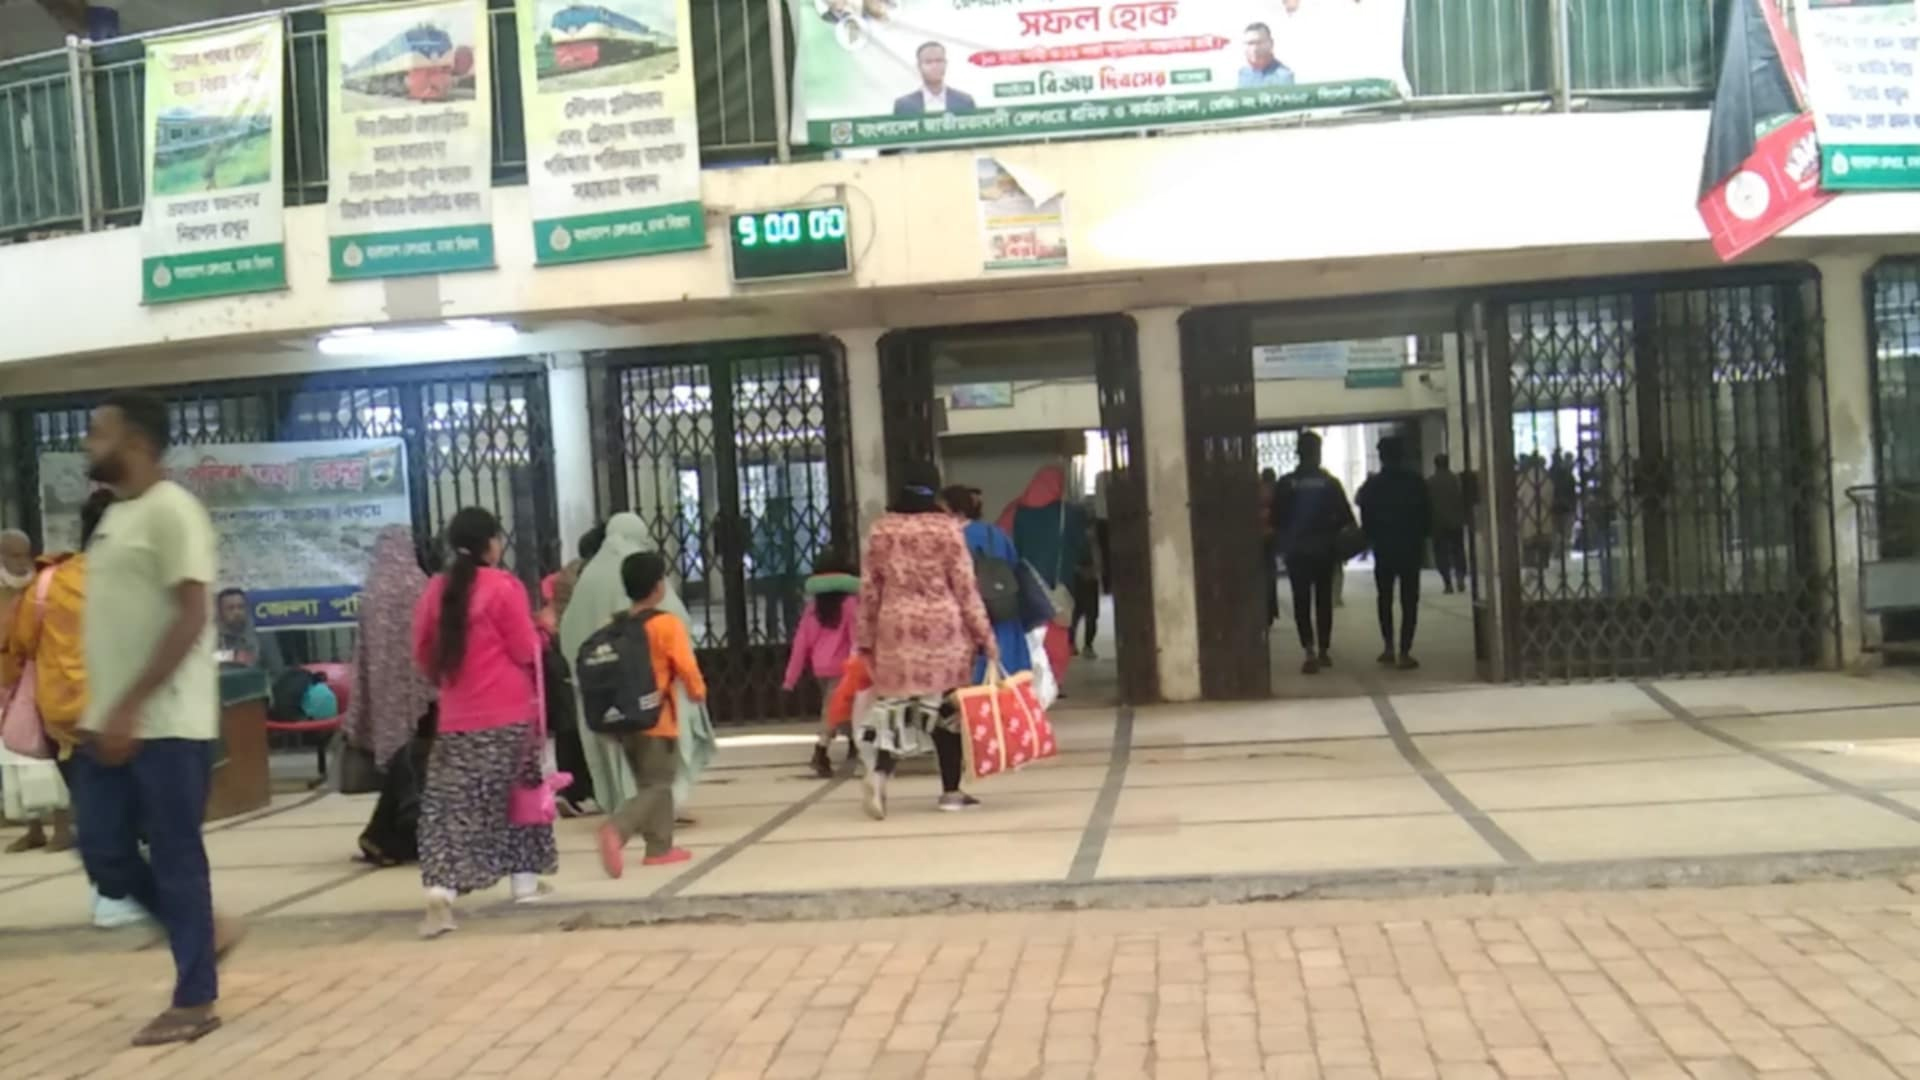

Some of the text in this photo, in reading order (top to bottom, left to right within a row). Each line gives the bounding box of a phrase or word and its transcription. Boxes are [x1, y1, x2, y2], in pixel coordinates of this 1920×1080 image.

[1017, 1, 1178, 35] সফল হোক
[1039, 70, 1094, 95] বিজয়
[1099, 66, 1167, 90] দিবসের
[855, 119, 920, 138] বাংলাদেশ
[923, 108, 1010, 133] জাতীয়তাবাদী
[1013, 109, 1067, 126] রেলওয়ে
[1070, 102, 1109, 121] শ্রমিক
[1114, 106, 1126, 118] ও
[738, 215, 757, 246] 9
[256, 599, 320, 619] জেলা
